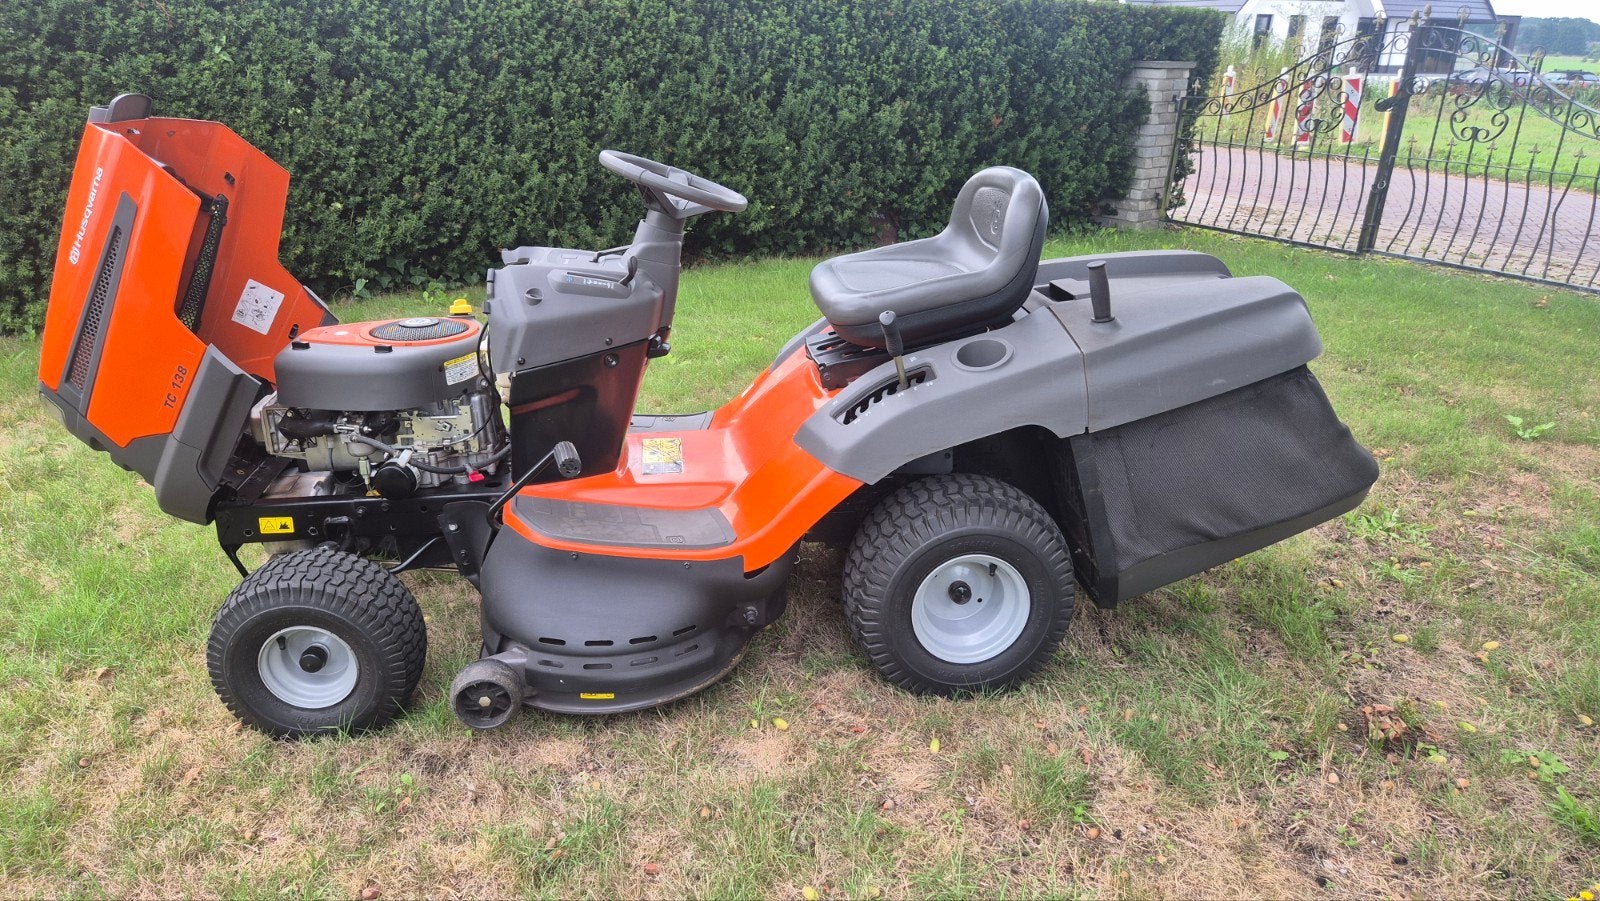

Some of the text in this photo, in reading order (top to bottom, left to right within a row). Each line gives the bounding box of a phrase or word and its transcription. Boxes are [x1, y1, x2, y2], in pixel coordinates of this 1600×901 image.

[74, 166, 103, 248] Husqvarna
[164, 365, 187, 409] TC 138
